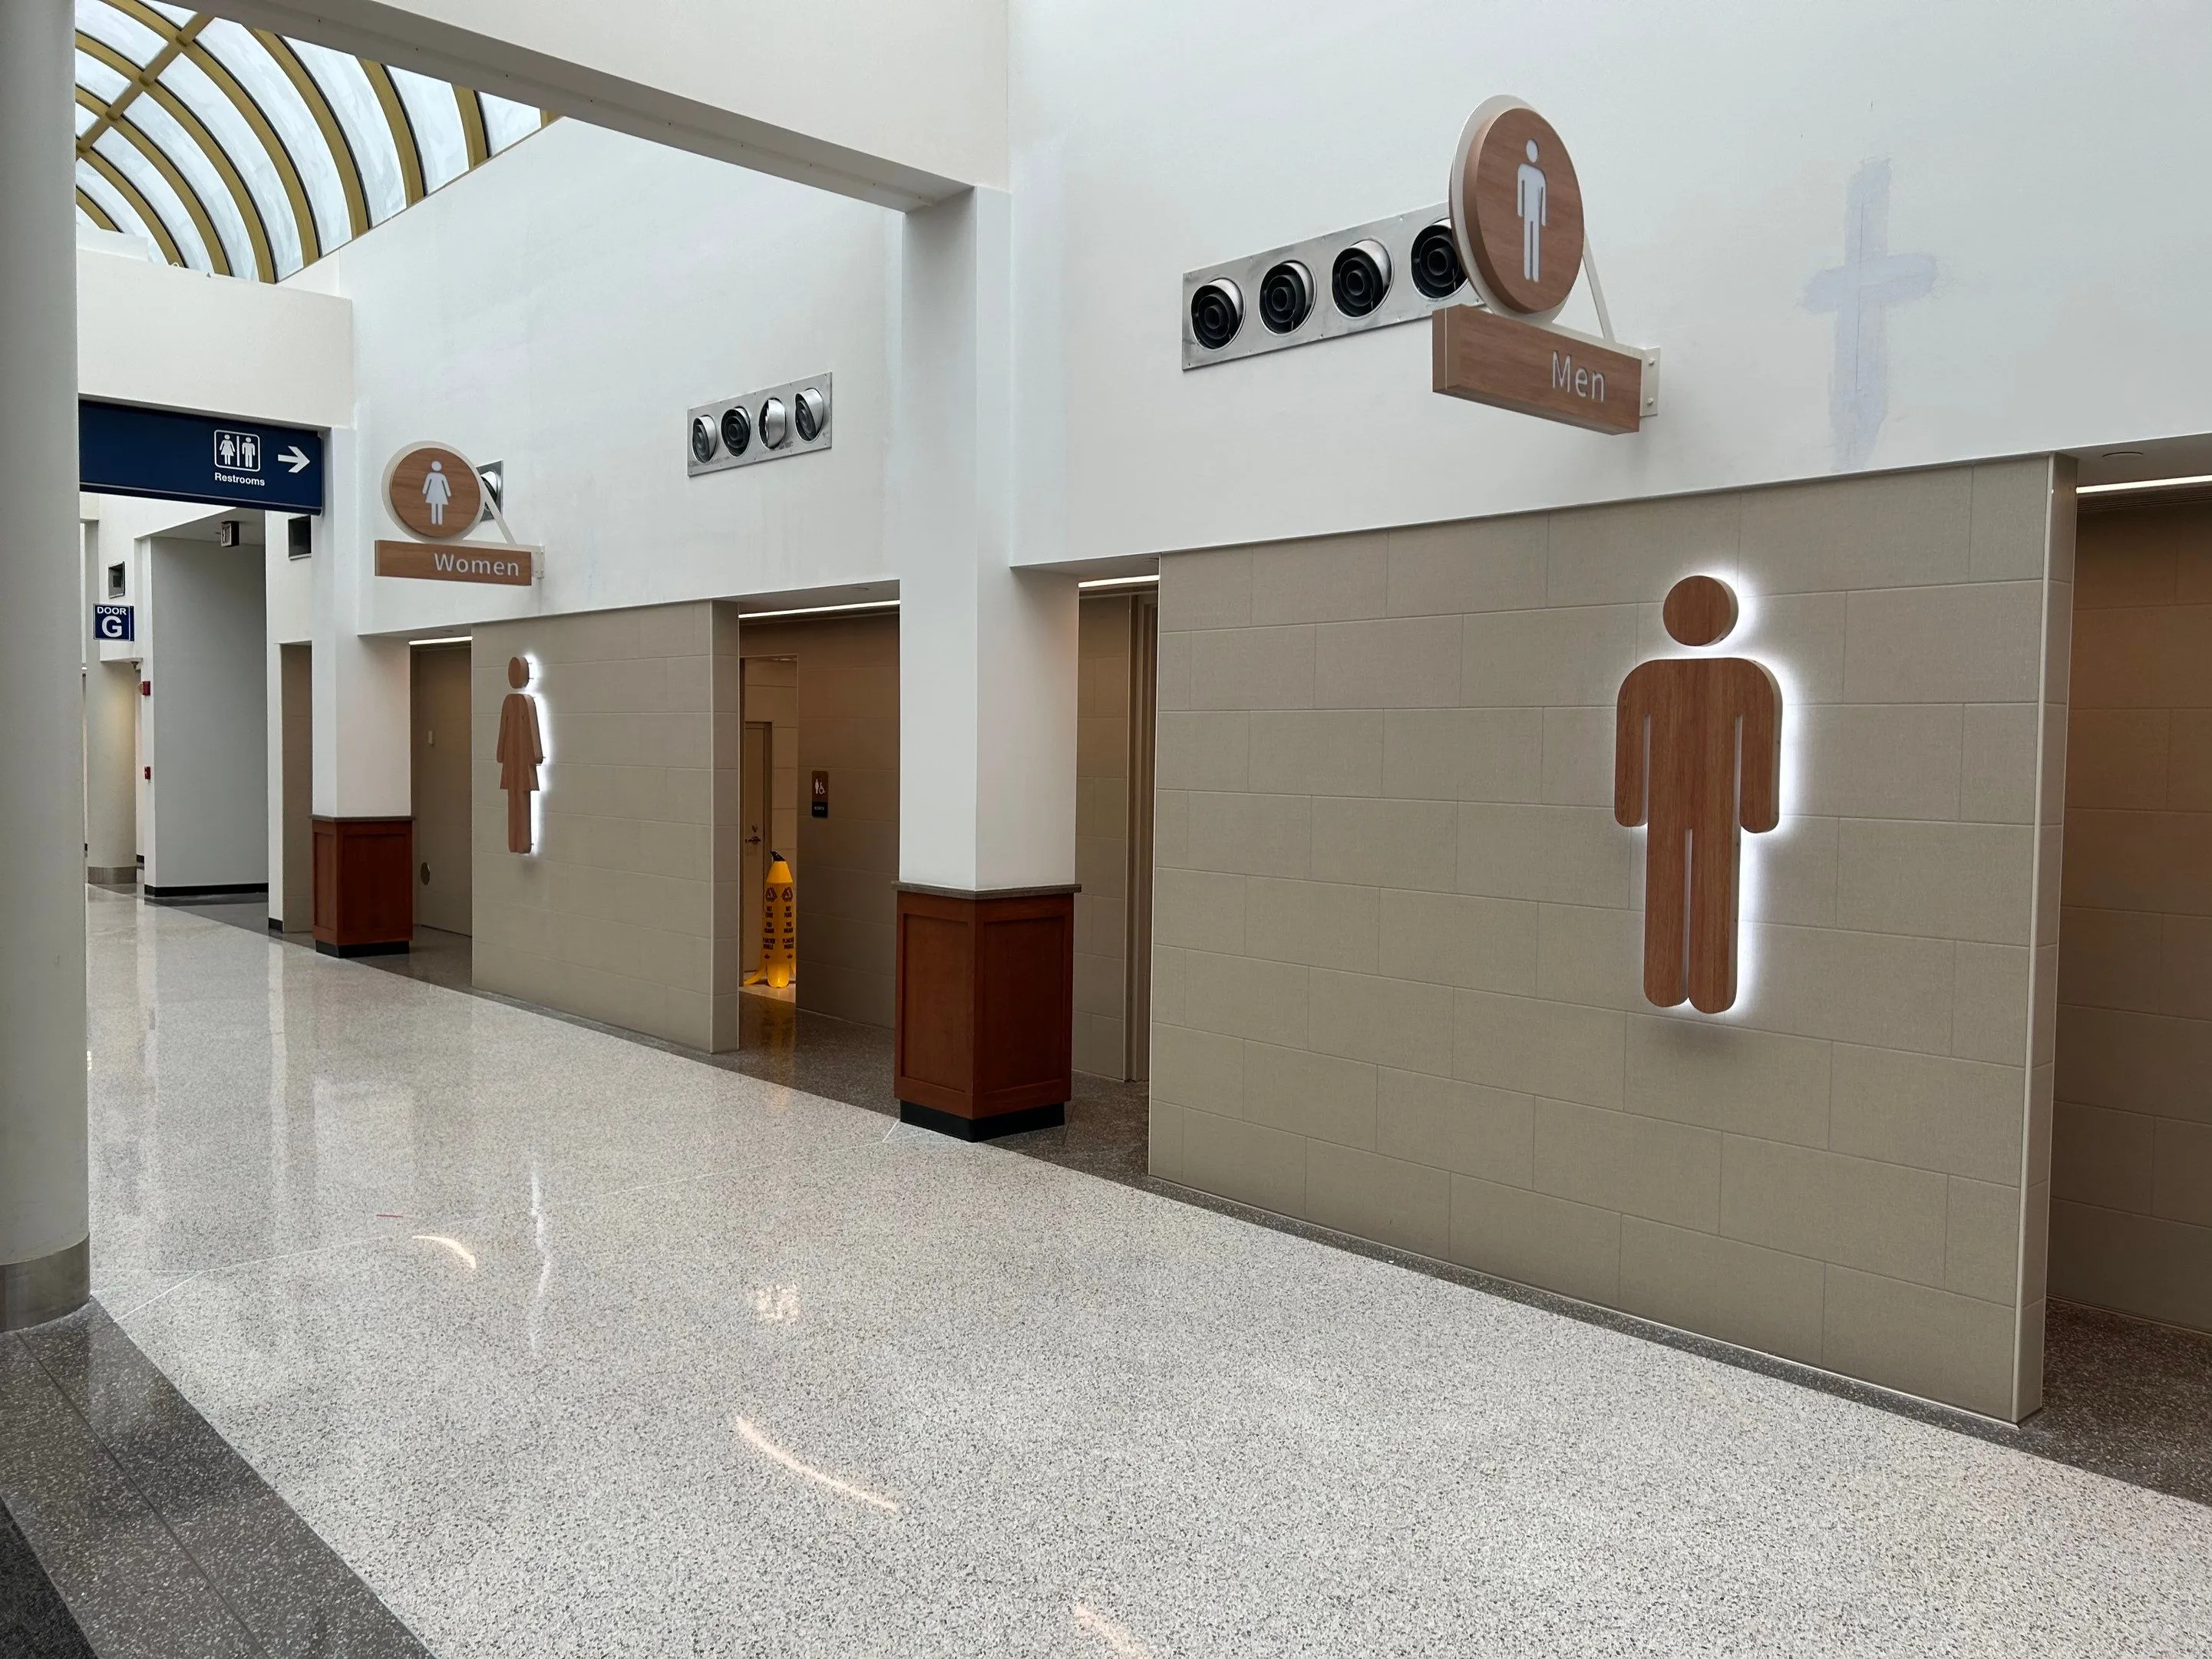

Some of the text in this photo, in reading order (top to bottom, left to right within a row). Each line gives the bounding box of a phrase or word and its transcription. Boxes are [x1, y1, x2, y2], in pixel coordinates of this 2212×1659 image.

[1553, 351, 1604, 402] Men
[214, 472, 266, 486] Restrooms
[434, 552, 520, 576] Women
[97, 606, 127, 615] DOOR
[101, 615, 123, 638] G
